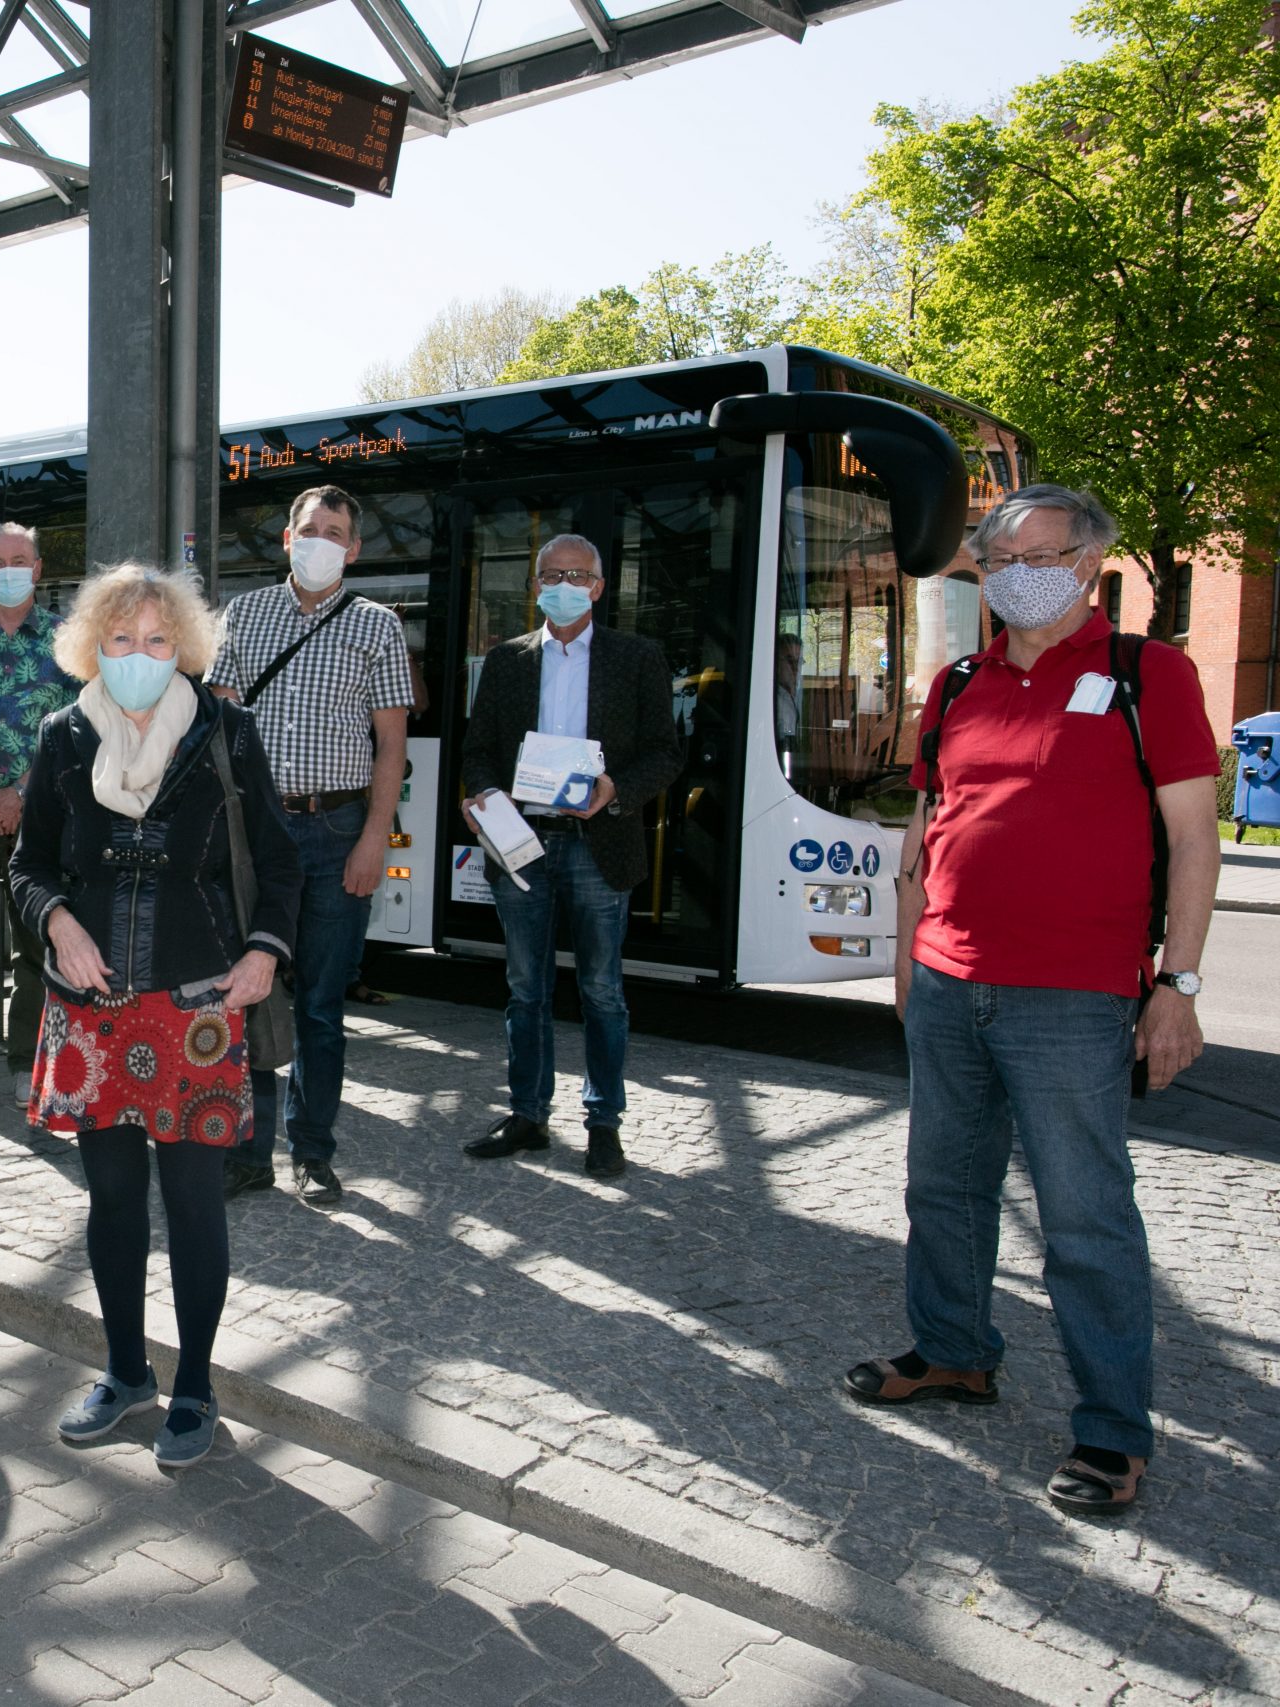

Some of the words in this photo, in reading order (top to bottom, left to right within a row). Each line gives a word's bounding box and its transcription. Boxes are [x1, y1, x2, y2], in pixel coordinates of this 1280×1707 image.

[280, 57, 289, 67] Ziel
[248, 77, 262, 93] 10
[251, 60, 264, 76] 51
[276, 70, 295, 87] Audi
[306, 81, 344, 104] Sportpark
[245, 94, 258, 109] 11
[272, 123, 284, 136] ab
[285, 126, 315, 150] Montag
[634, 409, 702, 431] MAN
[568, 429, 598, 439] Lion's
[601, 426, 626, 435] City
[228, 443, 251, 480] 51
[260, 442, 296, 469] Audi
[319, 427, 407, 465] Sportpark
